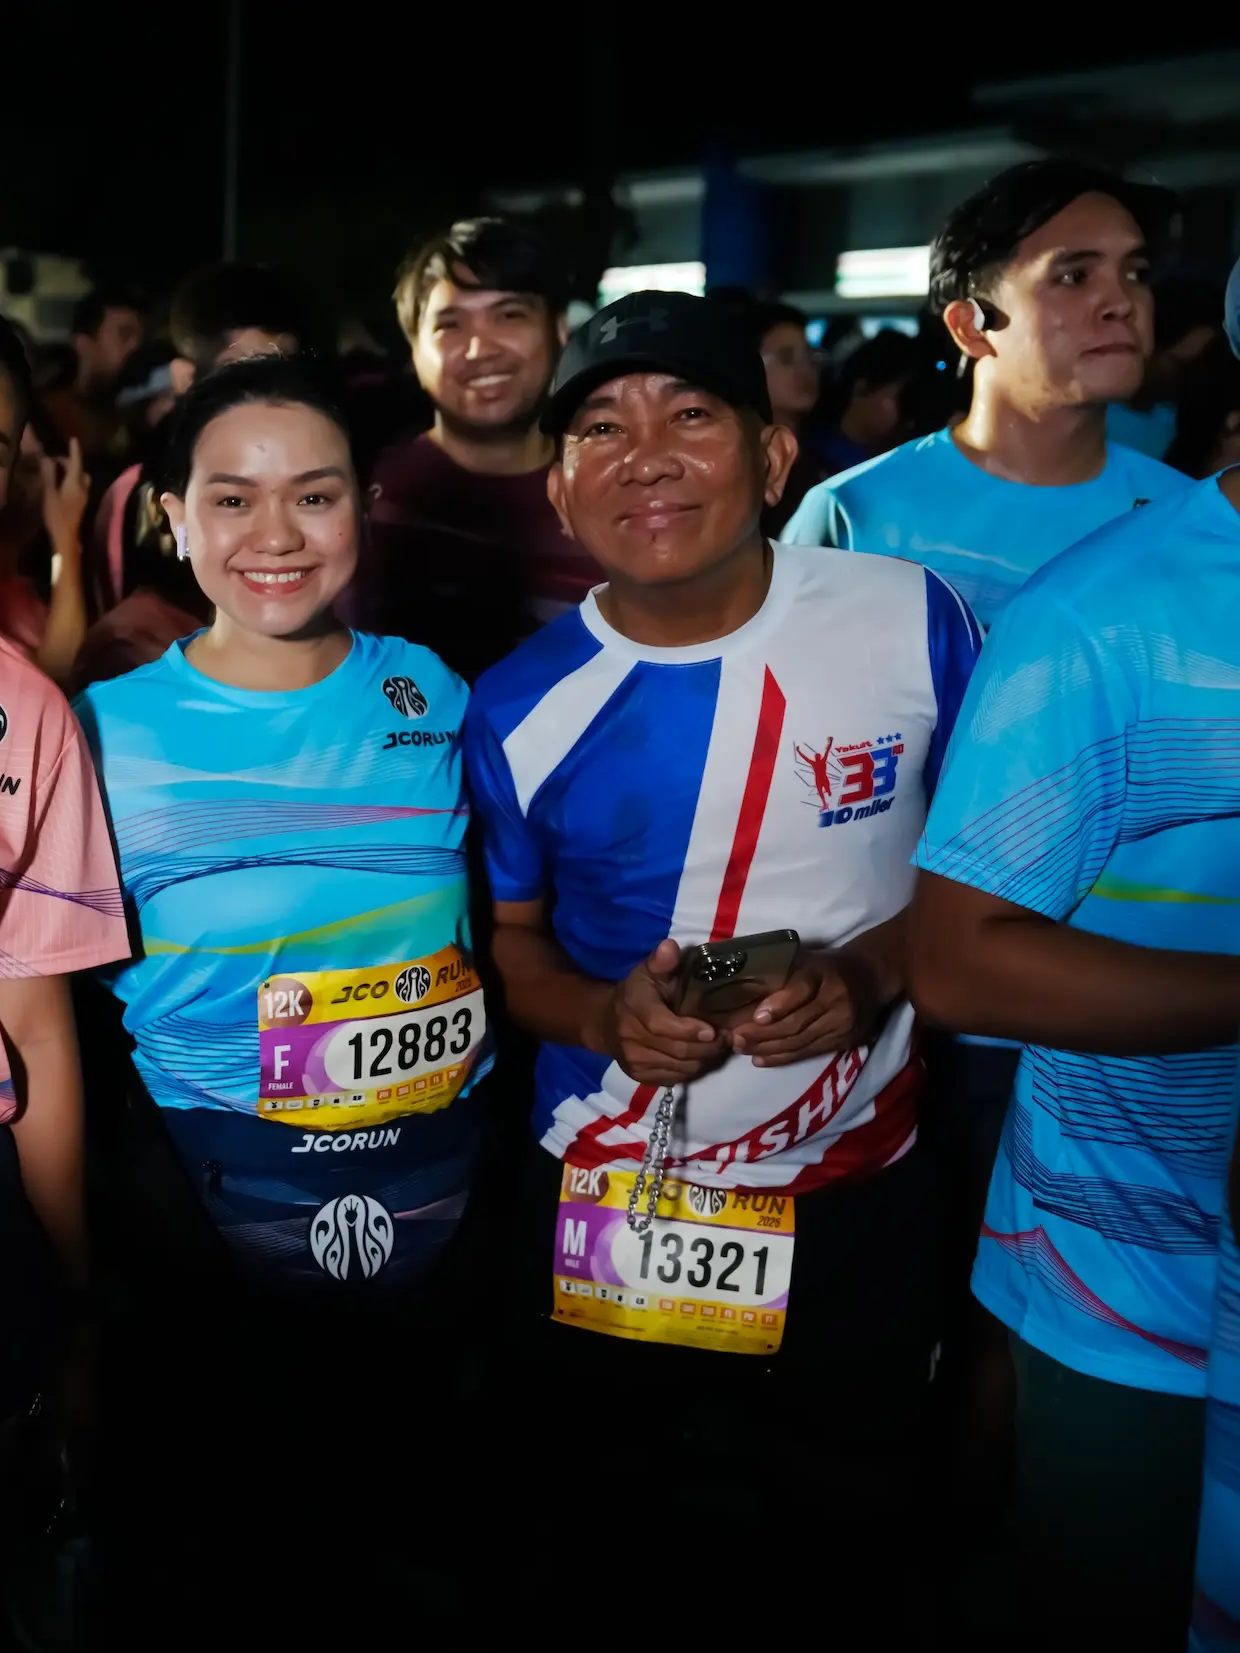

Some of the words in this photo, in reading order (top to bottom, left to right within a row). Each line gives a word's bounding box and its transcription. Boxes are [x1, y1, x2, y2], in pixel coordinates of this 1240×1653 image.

[838, 747, 898, 806] 33
[818, 806, 854, 828] 10
[853, 796, 895, 821] miler
[264, 989, 304, 1020] 12K
[331, 981, 389, 1004] JCO
[348, 1008, 472, 1080] 12883
[274, 1045, 291, 1080] F
[268, 1081, 294, 1091] FEMALE
[291, 1128, 401, 1153] JCORUN
[570, 1168, 602, 1197] 12K
[731, 1194, 787, 1215] RUN
[563, 1218, 587, 1257] M
[638, 1230, 769, 1296] 13321
